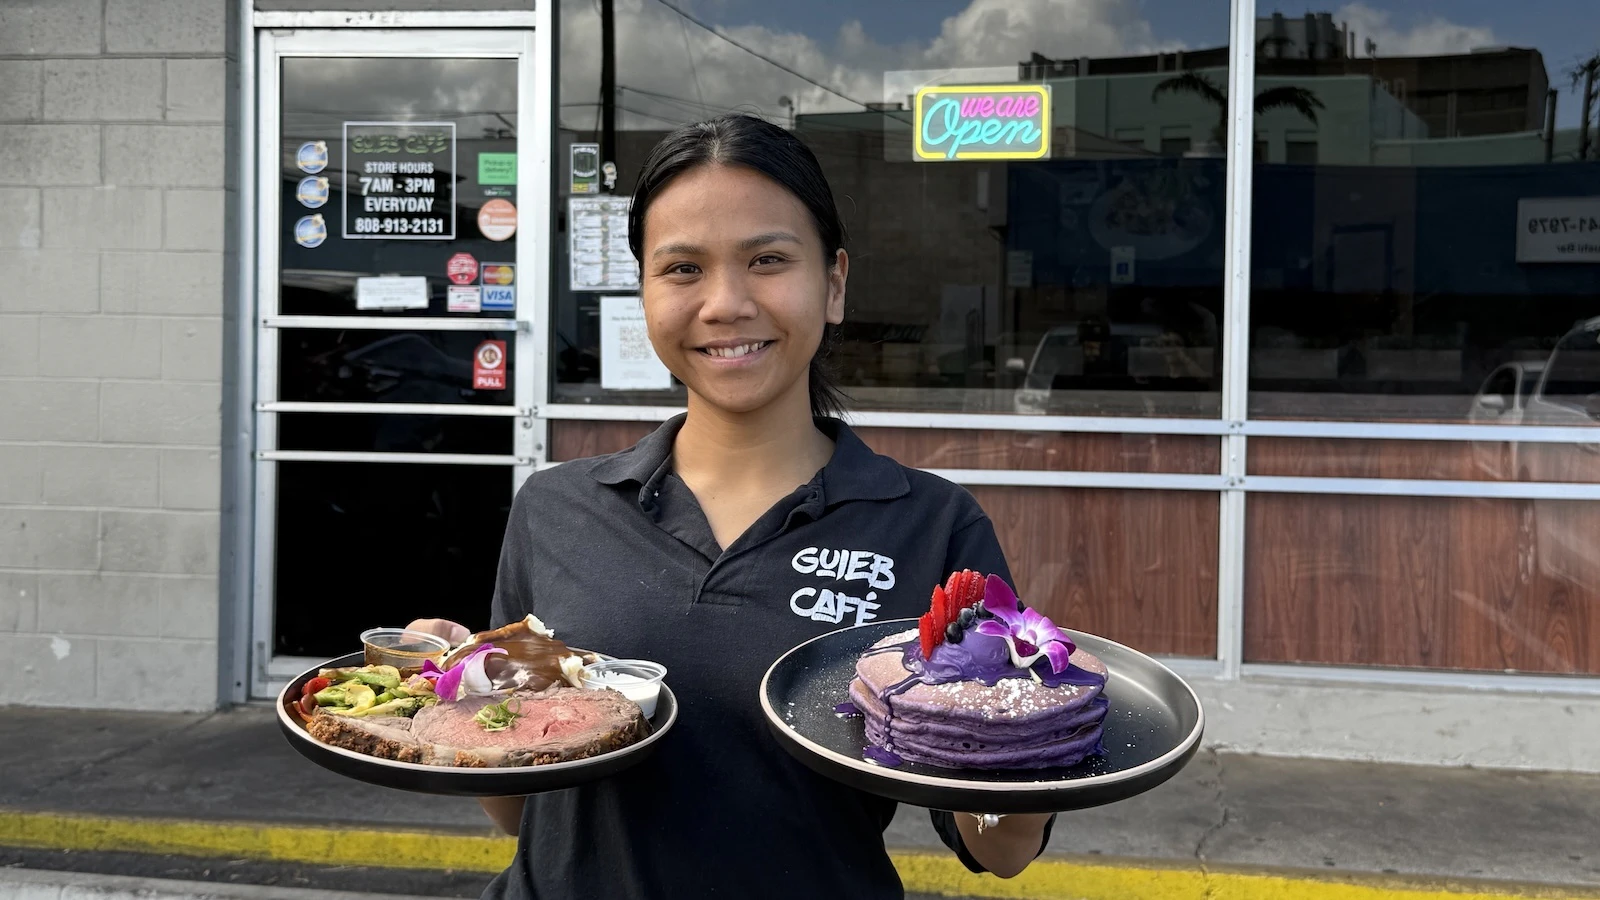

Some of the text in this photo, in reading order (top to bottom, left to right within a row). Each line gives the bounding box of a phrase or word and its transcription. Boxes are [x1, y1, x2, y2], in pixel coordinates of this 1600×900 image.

[961, 95, 1040, 117] we are
[922, 98, 1041, 159] Open
[364, 162, 434, 173] STORE HOURS
[359, 177, 393, 196] 7AM
[405, 178, 435, 193] 3PM
[364, 197, 434, 212] EVERYDAY
[355, 218, 444, 233] 808-913-2131
[486, 290, 512, 301] VISA
[477, 376, 502, 387] PULL
[791, 546, 896, 590] GUIEB
